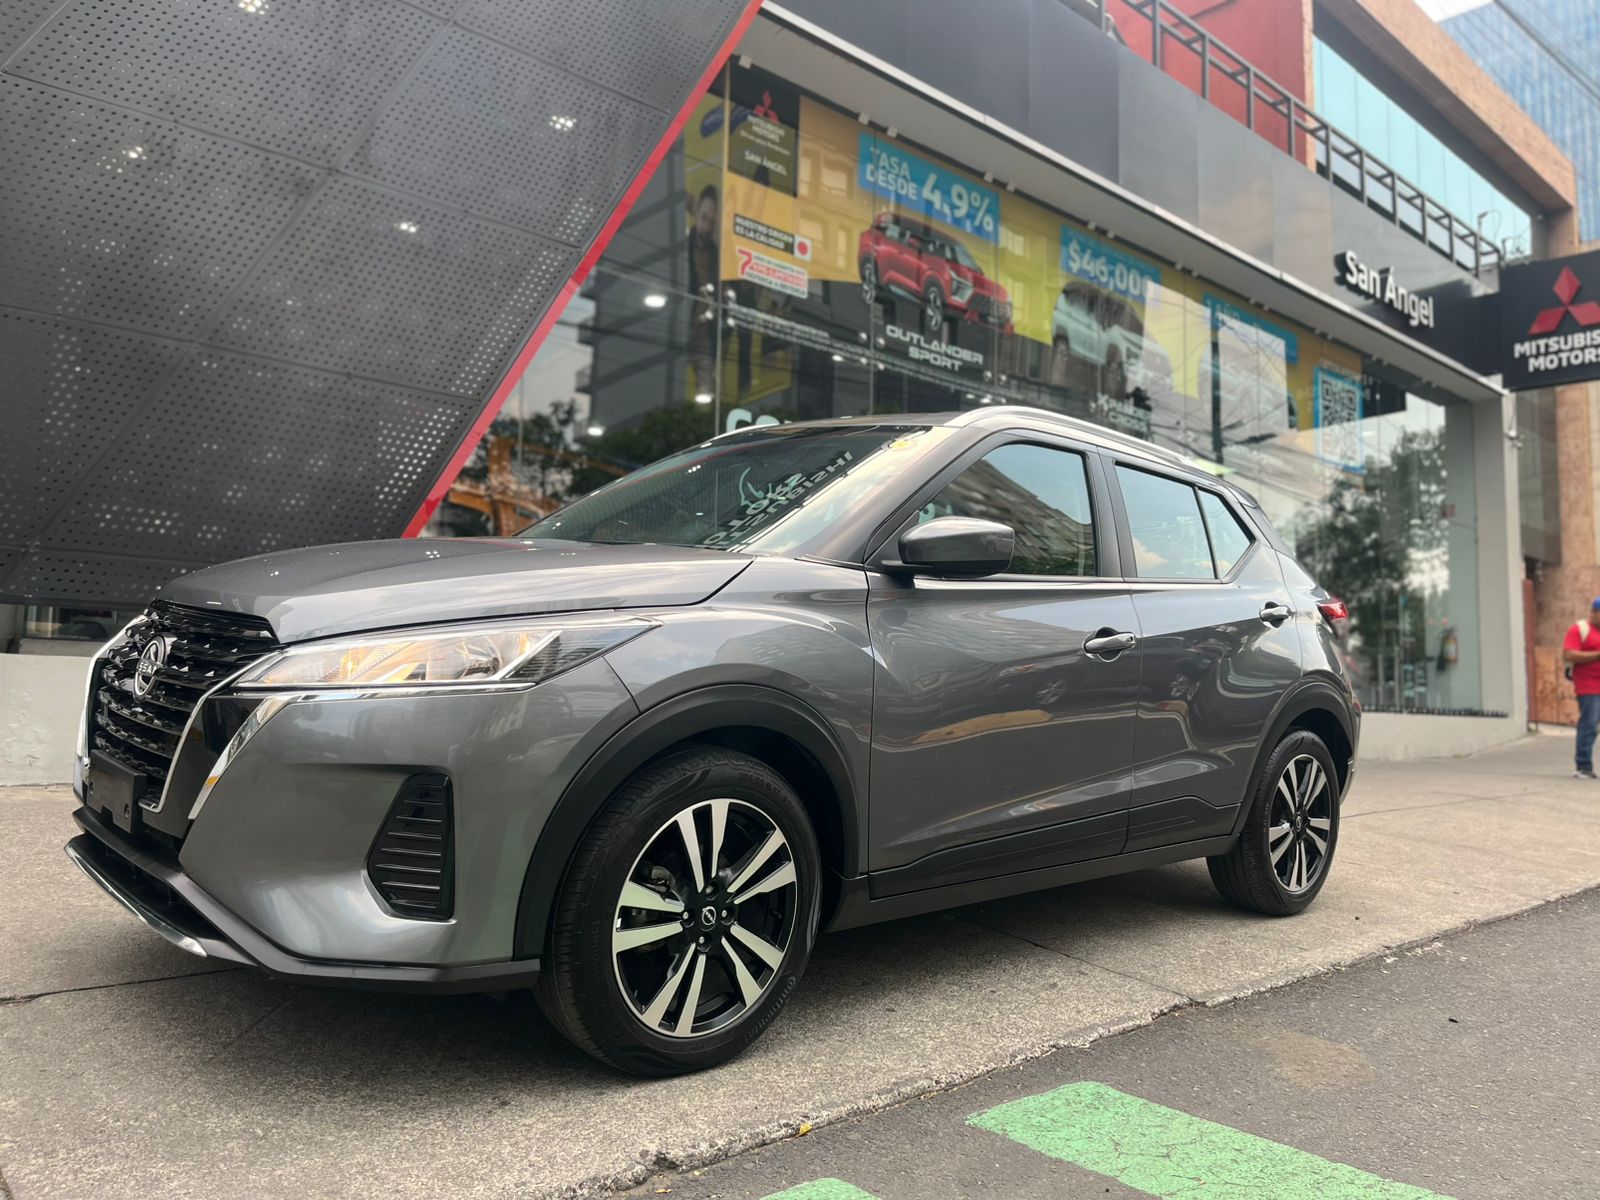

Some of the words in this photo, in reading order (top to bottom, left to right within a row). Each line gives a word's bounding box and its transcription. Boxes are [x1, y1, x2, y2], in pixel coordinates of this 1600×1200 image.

[870, 147, 911, 180] TASA
[866, 163, 918, 200] DESDE
[1345, 250, 1380, 299] San
[1384, 266, 1434, 328] Ángel
[886, 324, 984, 365] OUTLANDER
[908, 346, 963, 372] SPORT
[1528, 346, 1600, 373] MOTOR
